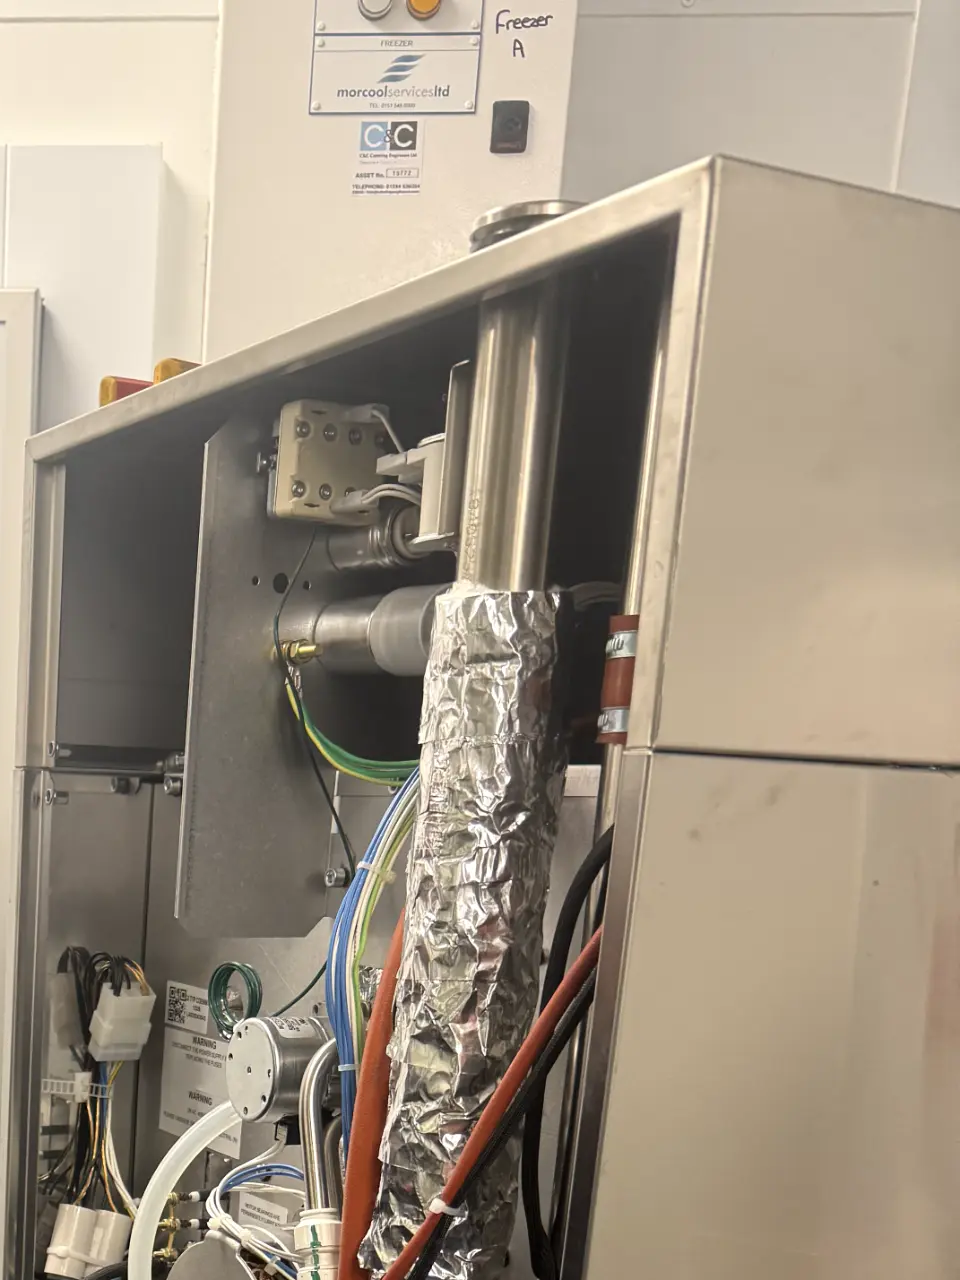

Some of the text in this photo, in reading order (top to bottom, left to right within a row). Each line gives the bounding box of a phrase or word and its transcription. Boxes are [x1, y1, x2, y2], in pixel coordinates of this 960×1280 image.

[495, 9, 554, 34] Freezer
[512, 38, 525, 58] A
[192, 1036, 217, 1050] WARNING
[188, 1091, 213, 1106] WARNING
